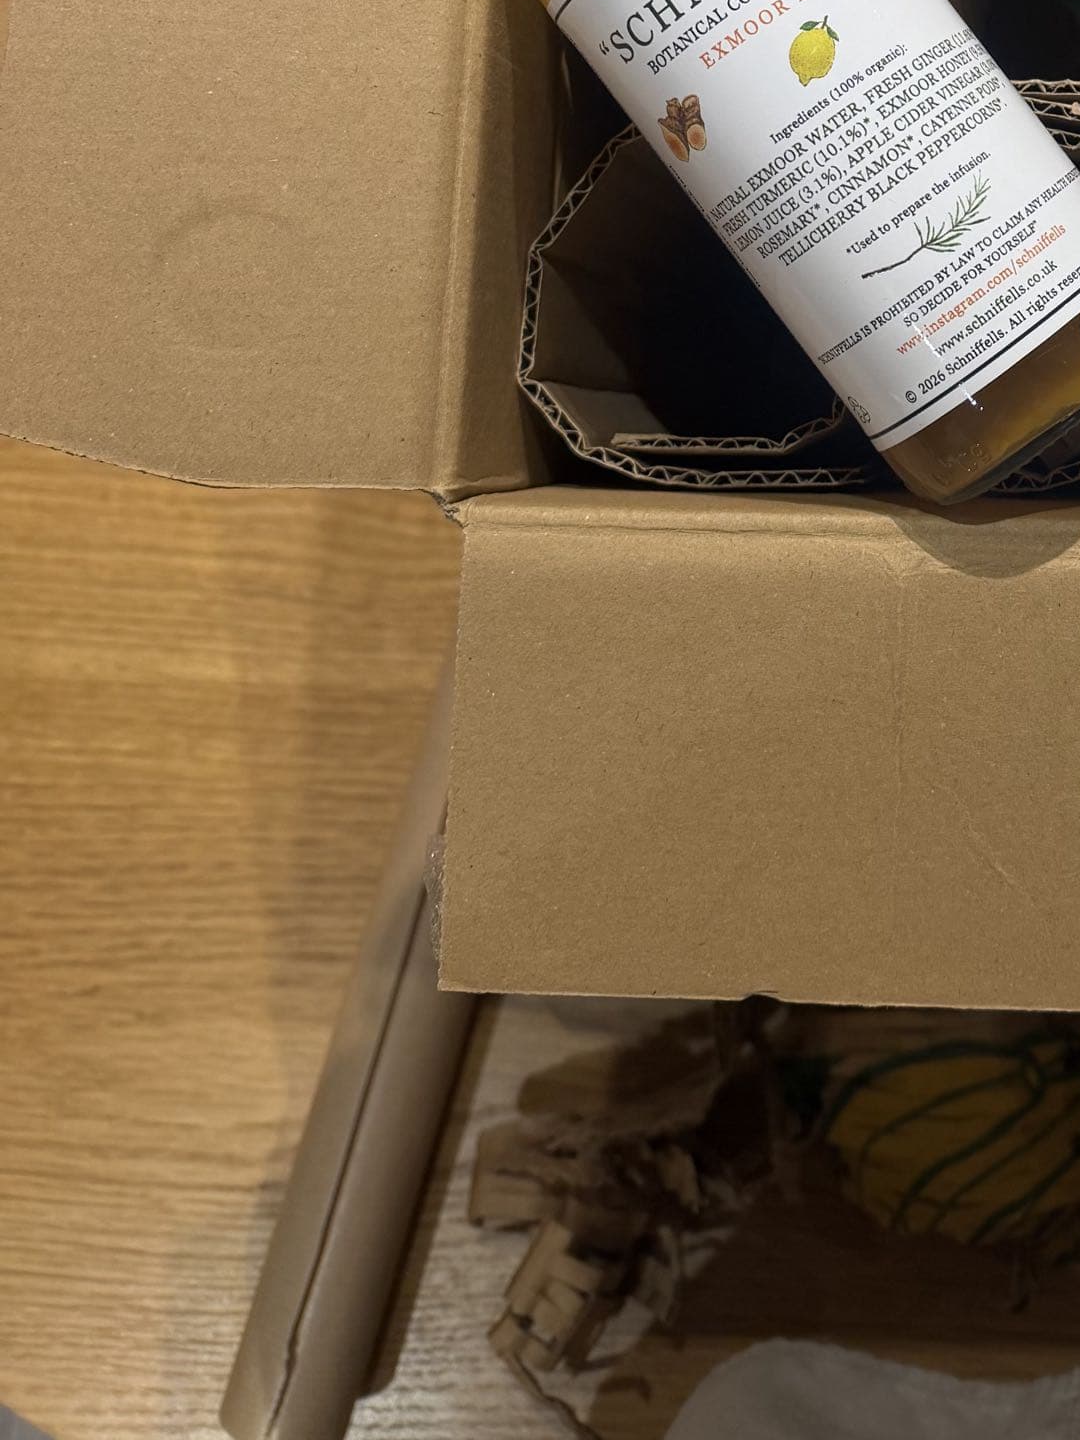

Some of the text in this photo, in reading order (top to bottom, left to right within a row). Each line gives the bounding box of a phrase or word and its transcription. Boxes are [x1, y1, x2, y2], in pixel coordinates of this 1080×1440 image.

[647, 8, 728, 74] BOTANICAL
[699, 0, 790, 69] EXMOOR
[710, 186, 751, 221] NATURAL
[747, 142, 808, 192] EXMOOR
[804, 103, 866, 145] WATER,
[863, 65, 913, 105] FRESH
[912, 39, 956, 71] GINGER
[723, 209, 751, 236] FRESH
[746, 160, 814, 216] TURMERIC
[876, 73, 939, 120] EXMOOR
[936, 50, 972, 79] HONEY
[770, 45, 907, 144] Ingredients (100% organic):
[921, 92, 979, 136] CAYENNE
[734, 223, 765, 251] LEMON
[763, 197, 800, 230] JUICE
[799, 166, 847, 203] (3.1%),
[848, 127, 894, 168] APPLE
[894, 97, 939, 131] CIDER
[936, 66, 984, 100] VINEGAR
[878, 224, 890, 235] to
[891, 193, 932, 228] prepare
[932, 180, 950, 195] the
[949, 152, 990, 182] infusion.
[779, 195, 867, 266] TELLICHERRY
[866, 159, 919, 202] BLACK
[860, 325, 872, 337] IS
[870, 280, 934, 330] PROHIBITED
[934, 267, 950, 284] BY
[950, 247, 975, 272] LAW
[975, 237, 992, 252] TO
[993, 211, 1025, 239] CLAIM
[1025, 197, 1042, 216] ANY
[1040, 177, 1068, 202] HEALTH
[904, 312, 919, 327] SO
[918, 281, 962, 316] DECIDE
[960, 264, 986, 285] FOR
[918, 370, 945, 394] 2026
[945, 329, 1008, 375] Schniffells.
[1009, 311, 1026, 330] All
[1026, 288, 1057, 315] rights
[936, 260, 1057, 356] www.schniffells.co.uk
